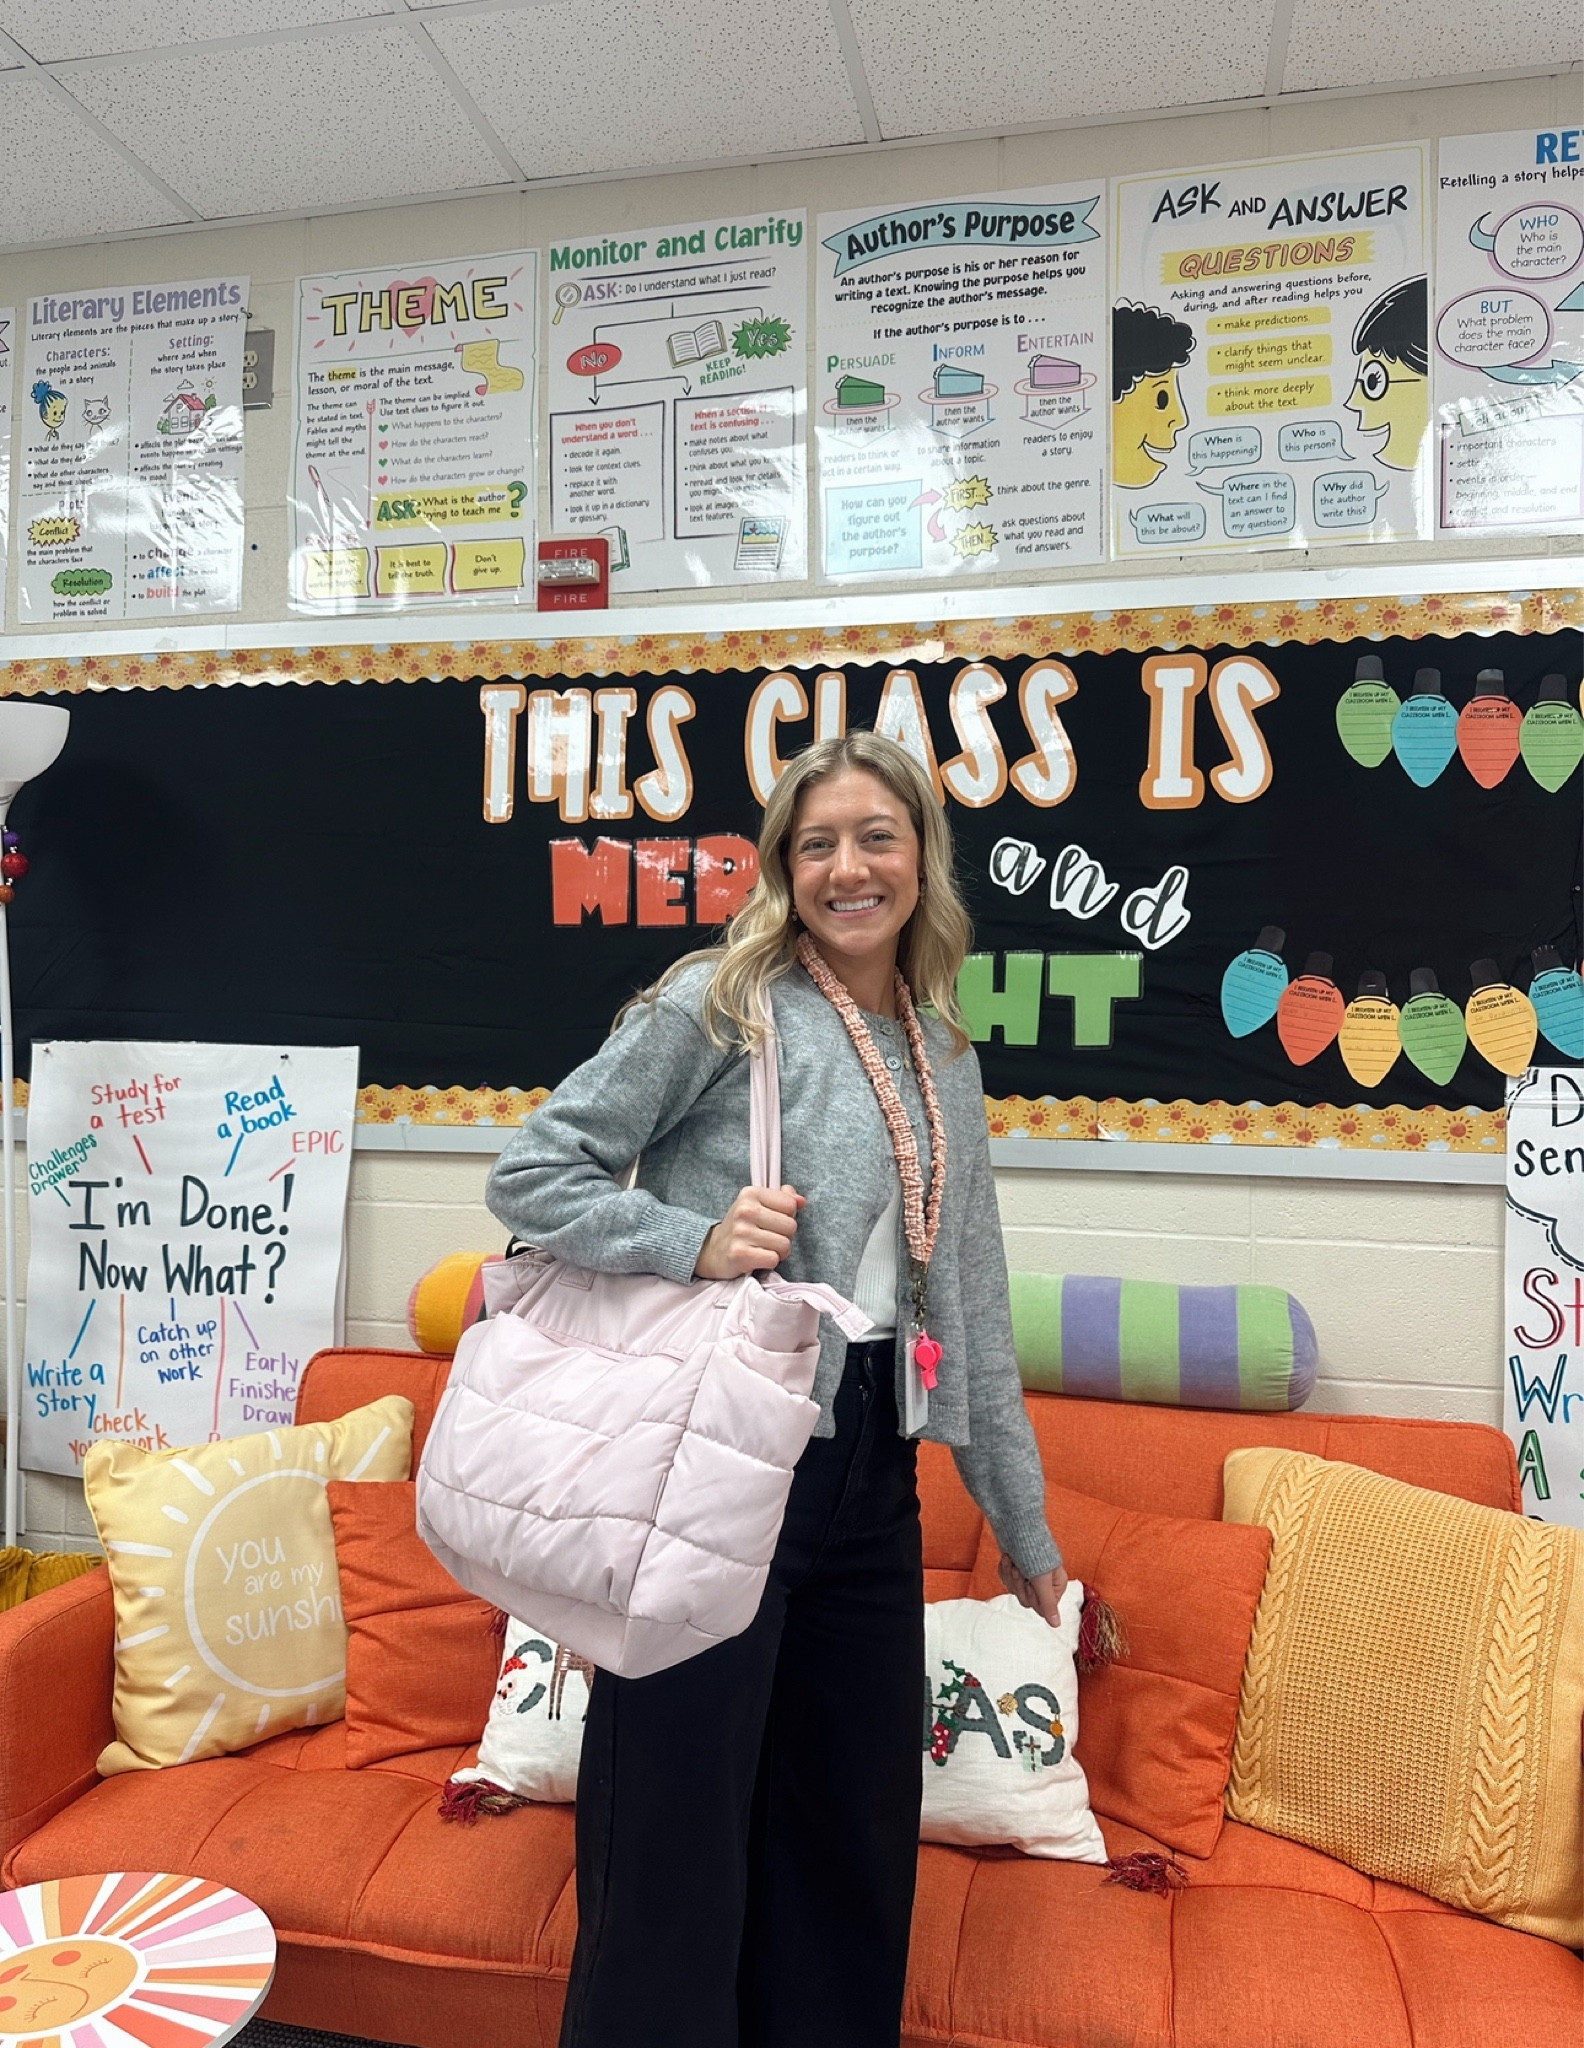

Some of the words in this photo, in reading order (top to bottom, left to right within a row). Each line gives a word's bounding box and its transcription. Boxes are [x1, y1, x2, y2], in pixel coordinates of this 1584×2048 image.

[1536, 131, 1584, 165] RE
[1440, 174, 1496, 189] Retelling
[1502, 174, 1509, 183] a
[1515, 170, 1547, 183] story
[1152, 181, 1221, 223] ASK
[1228, 197, 1266, 218] AND
[1267, 184, 1408, 230] ANSWER
[847, 213, 956, 259] Author's
[964, 211, 1075, 241] Purpose
[1520, 215, 1558, 230] WHO
[1521, 233, 1545, 242] Who
[1549, 231, 1558, 241] is
[550, 239, 647, 271] Monitor
[656, 230, 705, 258] and
[715, 217, 803, 250] Clarify
[1179, 237, 1355, 279] QUESTIONS
[1517, 245, 1532, 255] the
[1537, 243, 1562, 252] main
[841, 277, 855, 286] An
[858, 271, 901, 285] author's
[905, 267, 949, 281] purpose
[952, 264, 960, 274] is
[964, 261, 980, 272] his
[983, 262, 995, 270] or
[999, 258, 1018, 269] her
[1021, 255, 1058, 266] reason
[1063, 250, 1080, 261] for
[1511, 254, 1567, 268] character?
[583, 282, 622, 301] ASK:
[625, 285, 636, 293] Do
[645, 277, 696, 292] understand
[699, 273, 721, 285] what
[729, 270, 746, 285] just
[749, 267, 776, 280] read?
[835, 288, 873, 302] writing
[876, 289, 882, 298] a
[885, 285, 910, 296] text.
[914, 282, 959, 295] Knowing
[963, 278, 980, 288] the
[983, 273, 1029, 287] purpose
[1033, 269, 1062, 281] helps
[1066, 266, 1085, 277] you
[1171, 289, 1205, 301] Asking
[1209, 286, 1228, 296] and
[1231, 281, 1282, 294] answering
[1286, 276, 1333, 291] questions
[1337, 272, 1372, 284] before,
[33, 297, 124, 325] Literary
[133, 282, 241, 315] Elements
[321, 276, 508, 336] THEME
[1183, 300, 1218, 312] during,
[1222, 297, 1241, 308] and
[1245, 294, 1268, 305] after
[1272, 291, 1310, 305] reading
[1314, 287, 1339, 300] helps
[1343, 287, 1363, 299] you
[1481, 300, 1513, 313] BUT
[32, 332, 60, 341] Literary
[63, 328, 97, 338] elements
[116, 325, 127, 333] the
[131, 323, 154, 334] pieces
[158, 321, 172, 329] that
[176, 319, 195, 327] make
[198, 318, 207, 327] up
[874, 329, 880, 339] If
[885, 328, 902, 337] the
[906, 322, 949, 336] author's
[953, 317, 998, 331] purpose
[1002, 314, 1011, 324] is
[1458, 317, 1486, 328] What
[1491, 314, 1533, 325] problem
[1459, 330, 1483, 340] does
[1487, 328, 1503, 339] the
[1507, 328, 1532, 336] main
[47, 347, 110, 361] Characters:
[169, 334, 214, 349] Setting:
[581, 352, 607, 369] No
[747, 330, 778, 347] Yes
[828, 353, 896, 373] PERSUADE
[933, 343, 985, 362] INFORM
[1018, 332, 1094, 352] ENTERTAIN
[1455, 341, 1504, 353] character
[1508, 339, 1535, 350] face?
[308, 372, 324, 382] The
[328, 371, 356, 380] theme
[359, 368, 366, 377] is
[370, 366, 384, 376] the
[388, 364, 410, 374] main
[415, 361, 454, 372] message,
[706, 358, 731, 372] KEEP
[1205, 436, 1232, 446] When
[1285, 442, 1300, 452] this
[1303, 438, 1336, 451] person?
[1292, 428, 1315, 438] Who
[1319, 428, 1325, 436] is
[1192, 451, 1207, 460] this
[1210, 446, 1258, 460] happening?
[555, 548, 588, 557] FIRE
[554, 594, 587, 603] FIRE
[480, 684, 696, 823] THIS
[1139, 653, 1281, 809] IS
[989, 837, 1191, 949] and
[92, 1079, 149, 1106] Study
[154, 1074, 182, 1094] for
[225, 1075, 285, 1116] Read
[90, 1114, 103, 1130] a
[117, 1100, 167, 1128] test
[217, 1123, 232, 1139] a
[242, 1100, 297, 1136] book
[293, 1130, 344, 1153] EPIC
[28, 1133, 98, 1181] Challenges
[31, 1160, 81, 1196] Drawer
[68, 1176, 151, 1230] I'm
[181, 1173, 295, 1236] Done!
[79, 1239, 148, 1291] Now
[163, 1241, 286, 1304] What?
[138, 1320, 190, 1345] Catch
[196, 1319, 217, 1341] up
[140, 1348, 159, 1364] on
[169, 1342, 214, 1361] other
[246, 1352, 299, 1381] Early
[28, 1359, 83, 1388] Write
[90, 1362, 104, 1386] a
[158, 1362, 202, 1384] work
[39, 1392, 96, 1429] Story
[93, 1407, 148, 1433] Check
[215, 1535, 286, 1585] you
[244, 1570, 282, 1594] are
[291, 1560, 325, 1586] my
